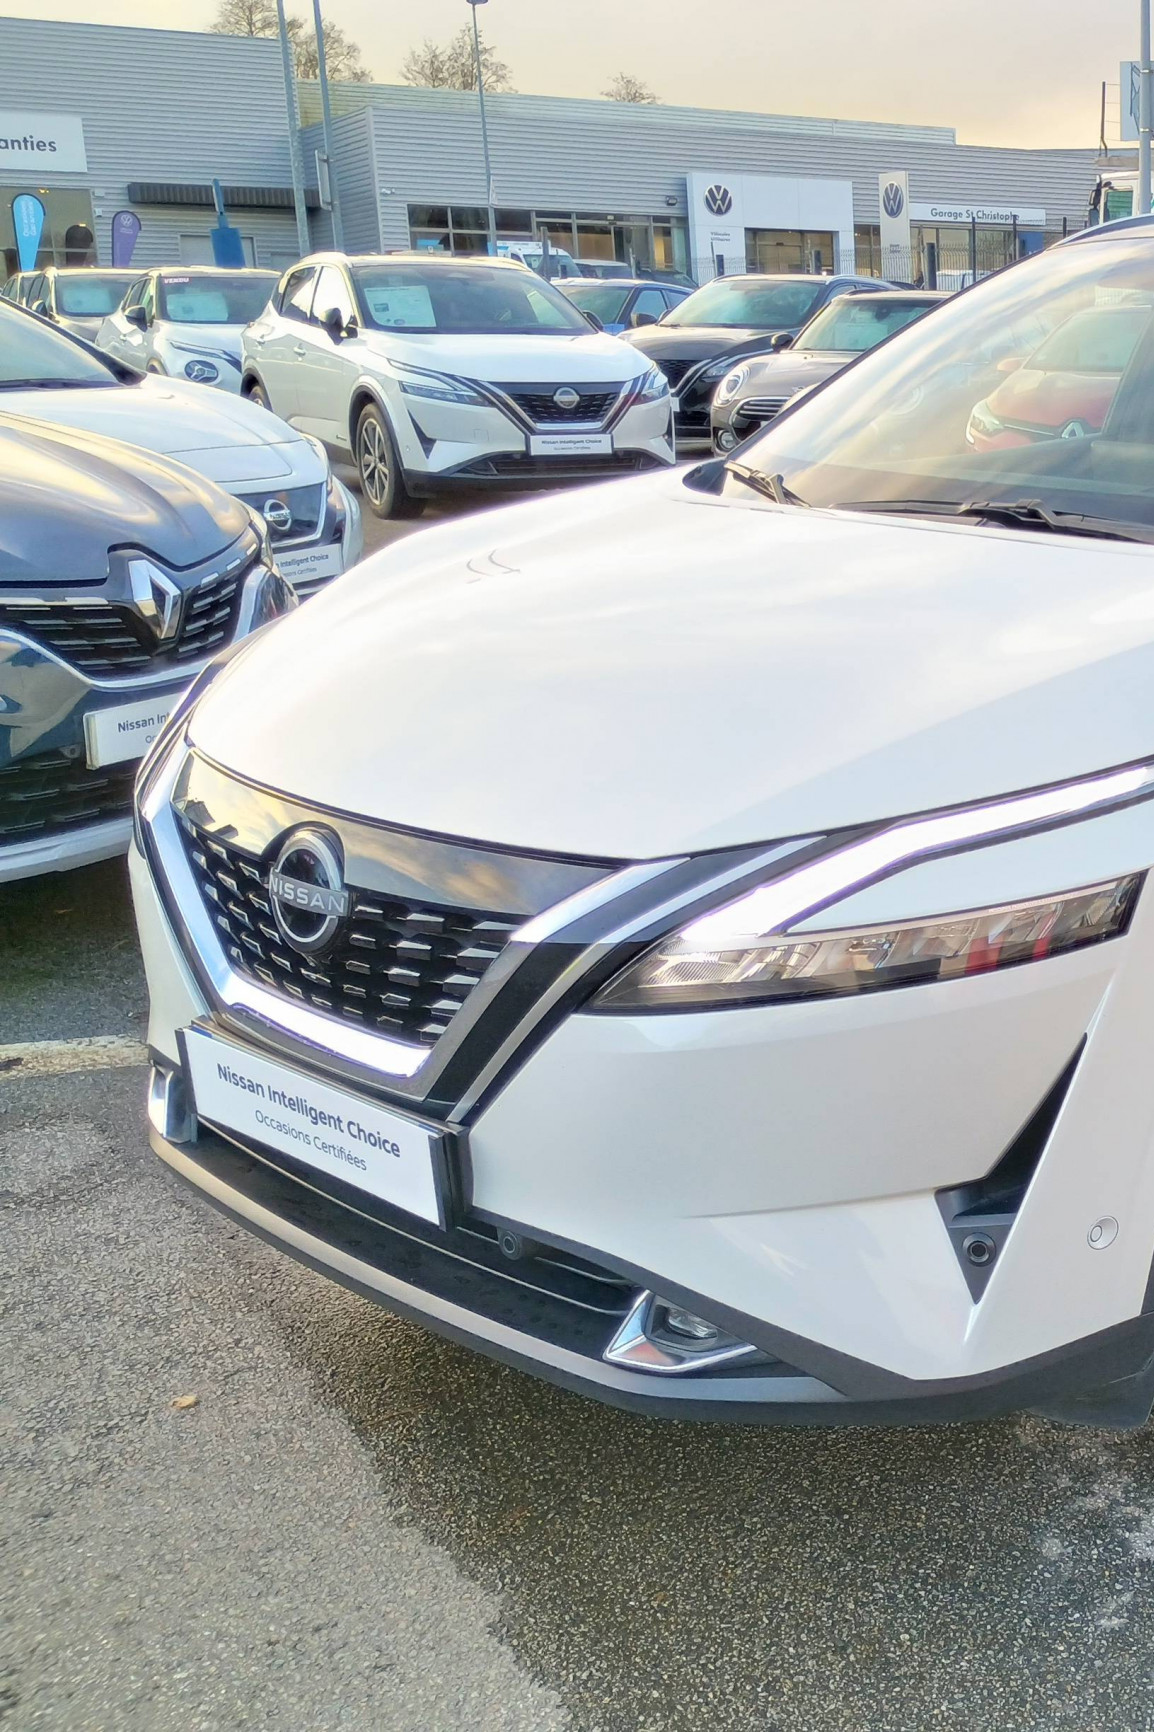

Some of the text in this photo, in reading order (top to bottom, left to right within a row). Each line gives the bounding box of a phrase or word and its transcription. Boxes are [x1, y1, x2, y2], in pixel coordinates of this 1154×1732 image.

[0, 135, 57, 152] anties
[930, 208, 1020, 222] Garage St Christophe
[281, 557, 309, 567] Intelligent
[310, 554, 329, 562] Choice
[117, 716, 155, 733] Nissan
[269, 873, 345, 914] NISSAN
[216, 1062, 401, 1159] Nissan Intelligent Choice
[255, 1109, 368, 1172] Occasions Certifiées
